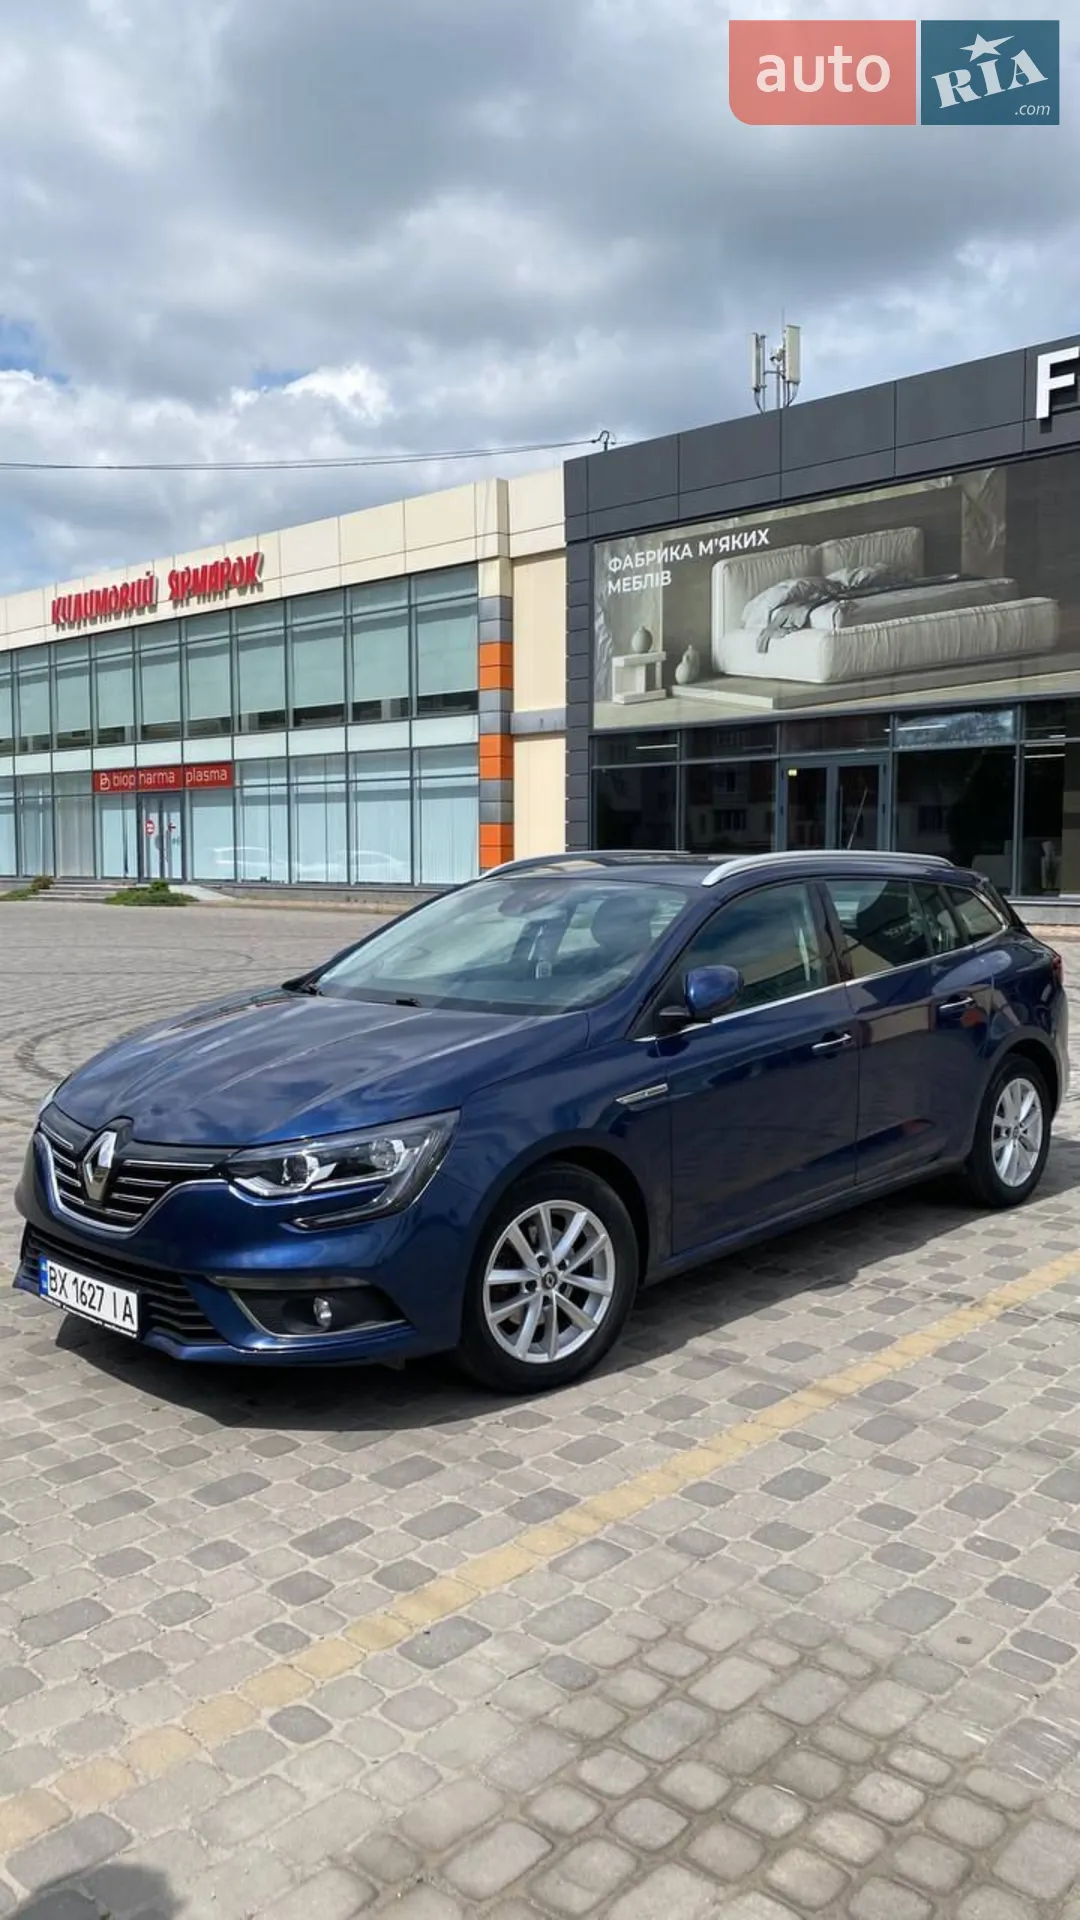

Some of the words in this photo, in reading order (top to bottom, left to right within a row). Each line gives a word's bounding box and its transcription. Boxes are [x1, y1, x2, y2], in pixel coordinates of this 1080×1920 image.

[608, 543, 694, 573] ФАБРИКА
[51, 571, 158, 625] КИЛИМОВИЙ
[168, 552, 264, 601] ЯРМАРОК
[607, 570, 672, 596] МЕБЛІВ
[185, 767, 228, 786] plasma
[49, 1266, 69, 1299] BX
[72, 1277, 105, 1313] 1627
